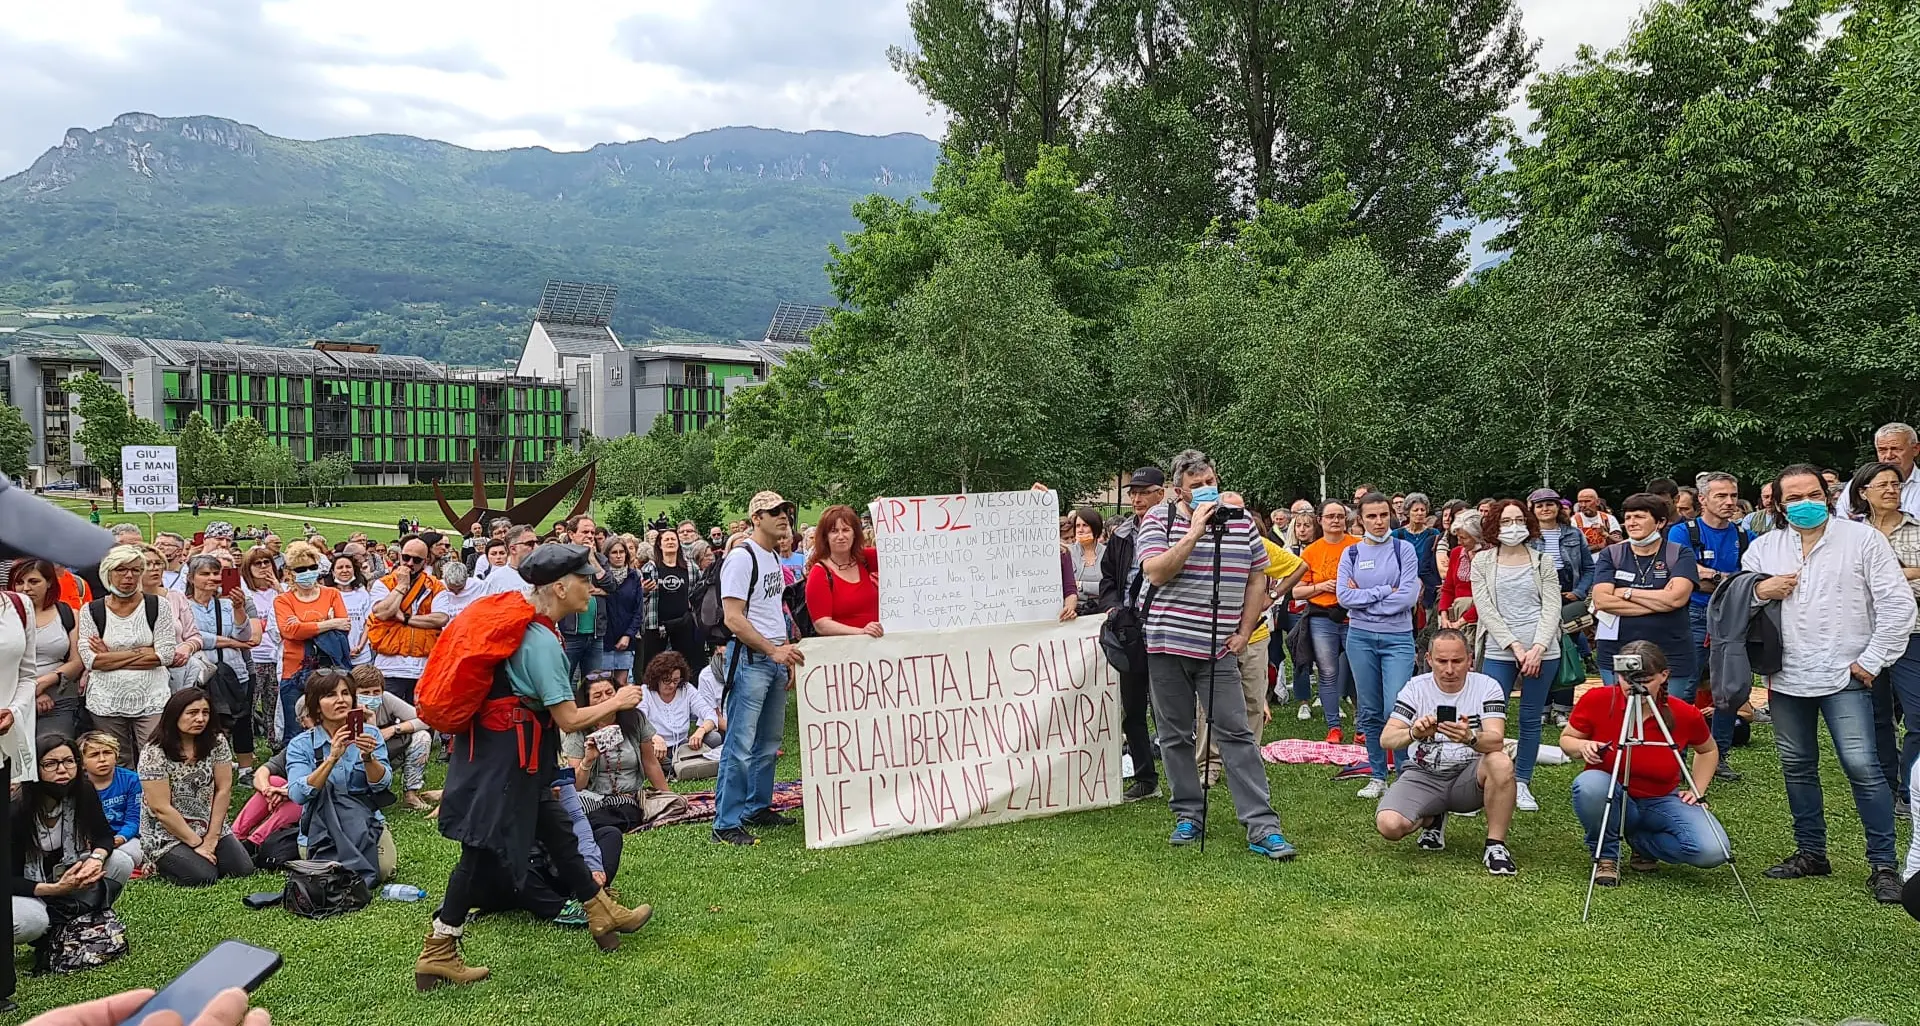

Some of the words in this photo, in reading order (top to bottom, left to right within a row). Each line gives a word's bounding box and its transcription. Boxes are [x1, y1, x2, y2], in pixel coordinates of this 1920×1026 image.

[125, 462, 141, 470] LE
[144, 461, 175, 470] MANI
[142, 473, 160, 482] dai
[128, 485, 174, 494] NOSTRI
[135, 496, 166, 505] FIGLI
[974, 492, 1053, 509] NESSUNO
[876, 498, 927, 534] ART.
[934, 495, 972, 532] 32
[1008, 509, 1058, 527] ESSERE
[878, 534, 949, 554] OBBLIGATO
[955, 536, 962, 548] A
[966, 535, 978, 546] UN
[981, 527, 1058, 546] DETERMINATO
[879, 549, 973, 569] TRATTAMENTO
[985, 543, 1055, 561] SANITARIO
[970, 584, 975, 599] I
[880, 608, 905, 620] DAL
[929, 608, 1016, 628] UMANA
[965, 647, 1003, 701] LA
[981, 700, 1041, 757] NON
[816, 779, 858, 841] NE
[961, 761, 997, 820] NE
[1006, 748, 1110, 811] L'ALTRA
